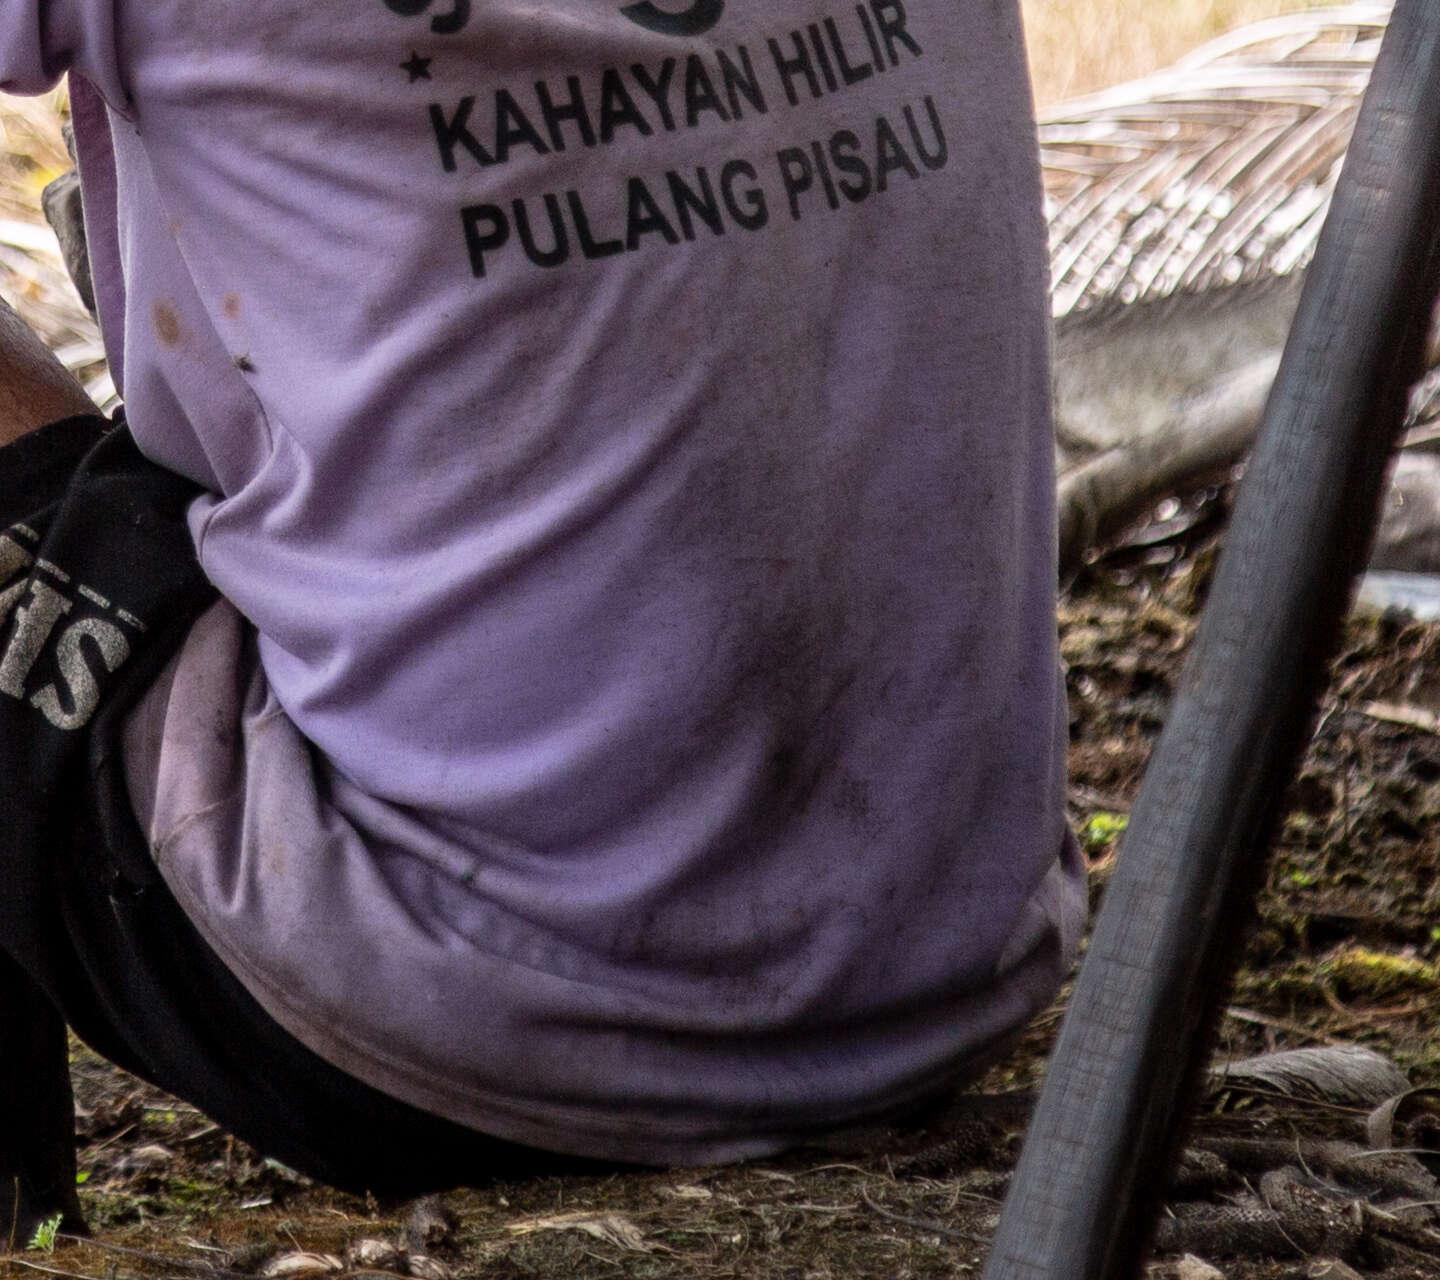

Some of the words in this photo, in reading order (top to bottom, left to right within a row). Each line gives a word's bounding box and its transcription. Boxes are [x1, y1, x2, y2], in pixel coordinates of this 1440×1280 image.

[427, 43, 768, 173] KAHAYAN
[458, 157, 771, 280] PULANG
[775, 94, 950, 221] PISAU
